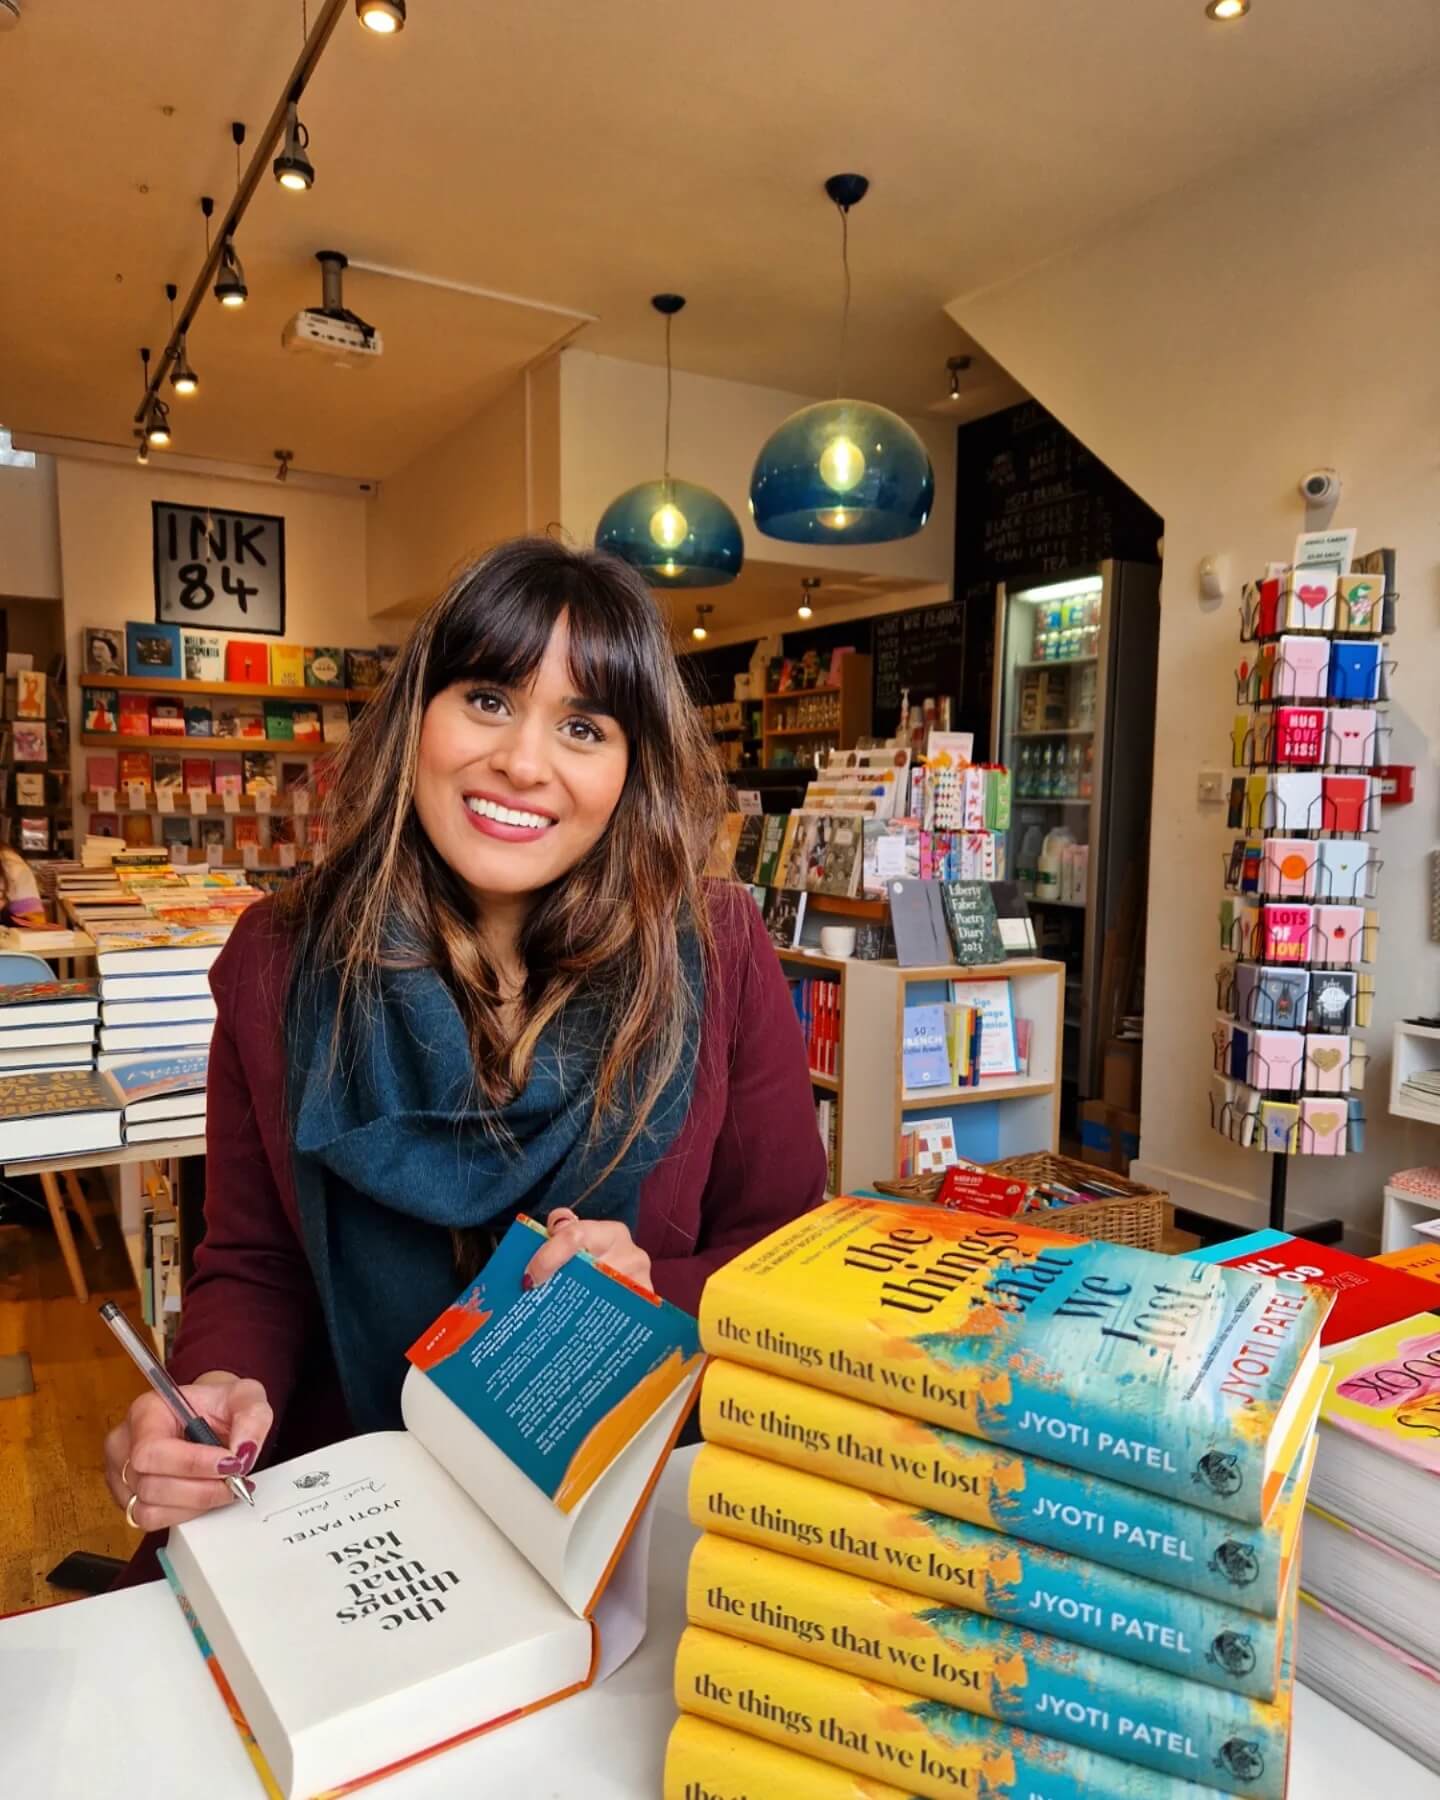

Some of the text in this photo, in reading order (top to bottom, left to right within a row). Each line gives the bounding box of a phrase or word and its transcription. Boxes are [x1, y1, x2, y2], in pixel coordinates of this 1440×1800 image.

[168, 513, 267, 566] INK
[178, 565, 259, 614] 84
[1289, 714, 1317, 728] HUG
[949, 884, 982, 899] Liberty
[952, 899, 977, 909] Faber
[955, 912, 985, 927] Poetry
[959, 926, 985, 942] Diary
[1271, 911, 1307, 925] LOTS
[1271, 926, 1291, 940] OF
[962, 942, 984, 952] 2023
[844, 1228, 933, 1273] the
[880, 1226, 1019, 1314] things
[1238, 1258, 1286, 1274] TH
[1278, 1265, 1325, 1282] GO
[970, 1252, 1074, 1314] that
[1054, 1275, 1132, 1319] we
[1101, 1281, 1215, 1348] lost
[717, 1317, 969, 1410] the things that we lost
[1220, 1293, 1309, 1405] JYOTI PATEL
[719, 1398, 981, 1496] the things that we lost
[1018, 1410, 1178, 1473] JYOTI PATEL
[283, 1499, 402, 1545] JYOTI PATEL
[708, 1492, 977, 1589] the things that we lost
[1032, 1496, 1194, 1562] JYOTI PATEL
[325, 1530, 403, 1565] lost
[347, 1549, 404, 1575] we
[336, 1570, 461, 1625] things
[344, 1559, 426, 1598] that
[379, 1597, 447, 1631] the
[1029, 1590, 1191, 1654] JYOTI PATEL
[707, 1586, 983, 1691] the things that we lost
[695, 1673, 970, 1788] the things that we lost
[1035, 1693, 1199, 1759] JYOTI PATEL
